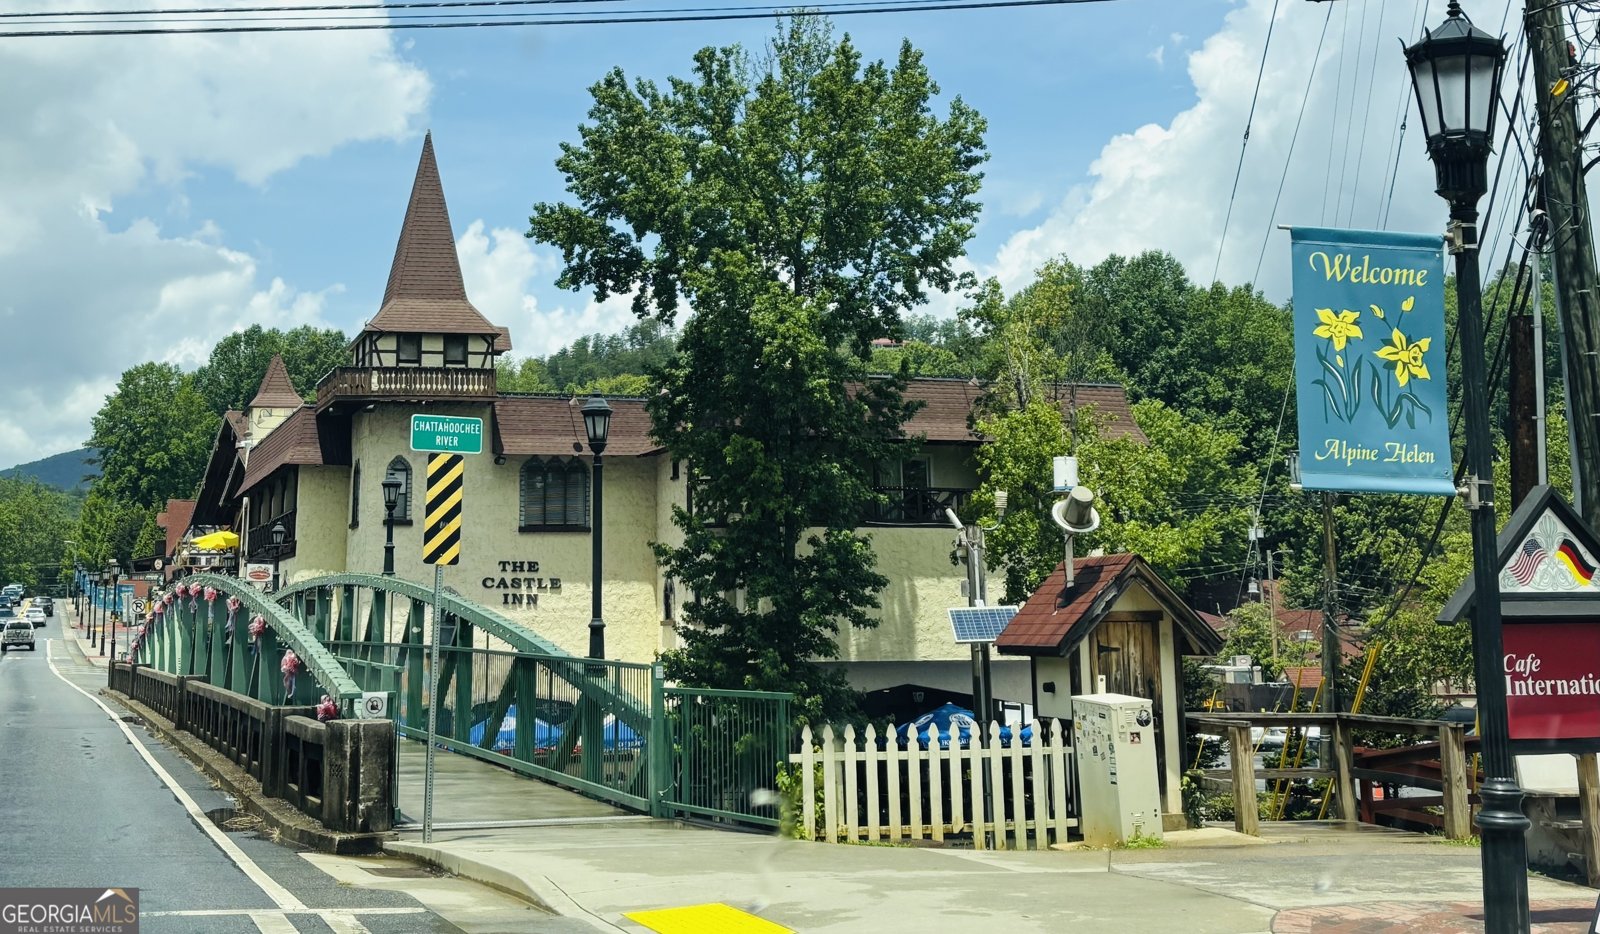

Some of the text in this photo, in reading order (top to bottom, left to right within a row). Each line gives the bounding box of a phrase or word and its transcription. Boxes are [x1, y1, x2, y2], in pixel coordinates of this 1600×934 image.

[1309, 251, 1428, 287] Welcome
[414, 421, 480, 434] CHATTAHOOCHEE
[435, 435, 459, 446] RIVER
[1314, 438, 1435, 467] Alpine Helen
[498, 561, 539, 572] THE
[482, 577, 561, 589] CASTLE
[503, 593, 538, 604] INN
[1503, 653, 1541, 677] Cafe
